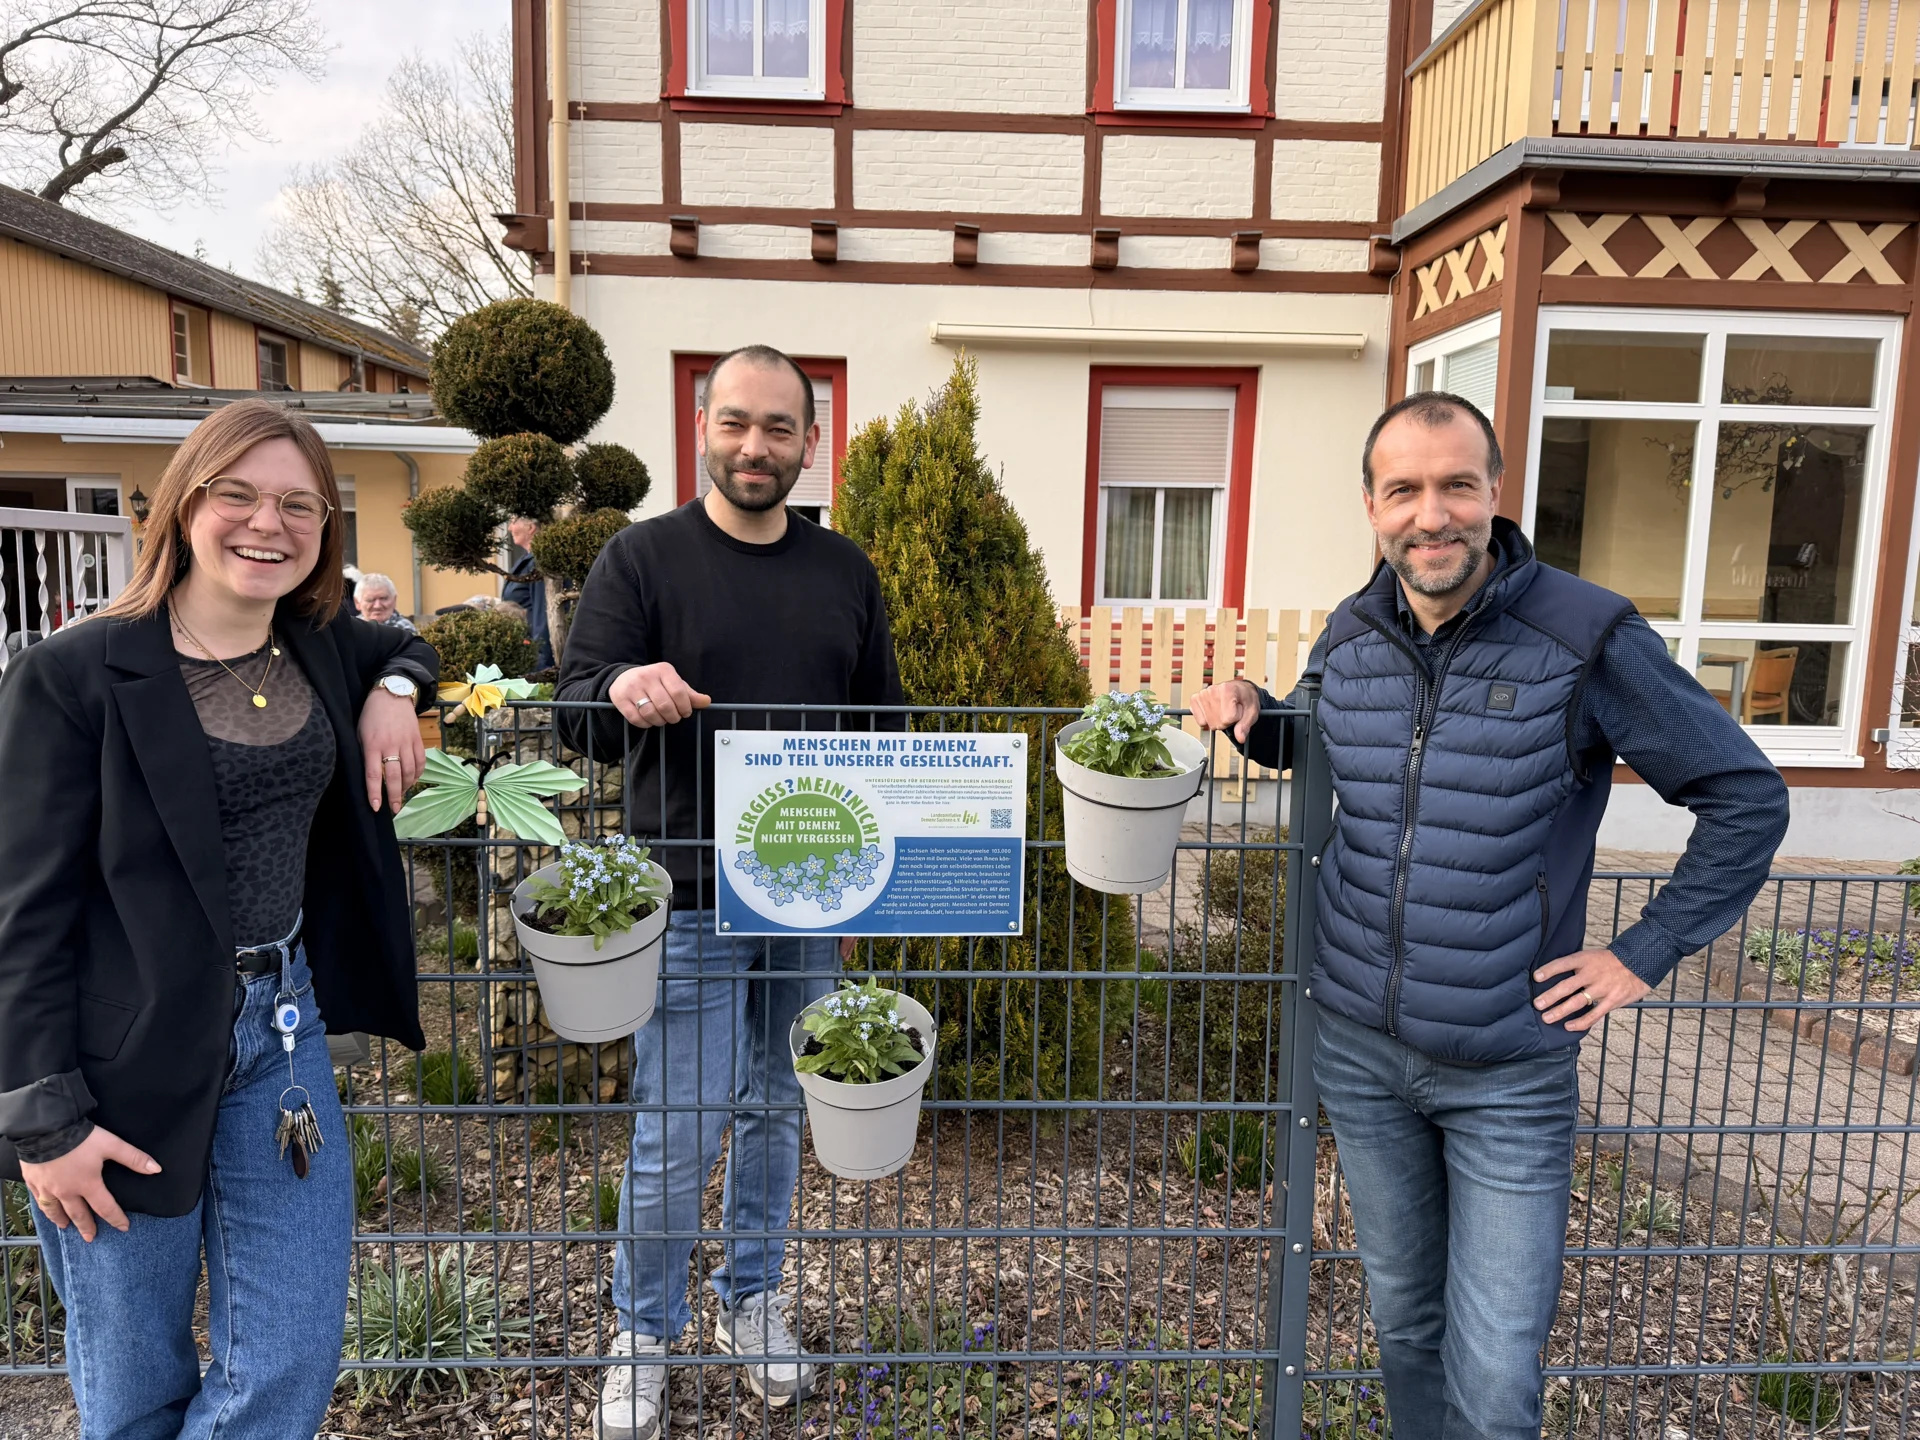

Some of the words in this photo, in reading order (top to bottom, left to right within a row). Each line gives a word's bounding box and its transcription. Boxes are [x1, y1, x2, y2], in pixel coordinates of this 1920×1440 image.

[783, 739, 870, 751] MENSCHEN
[877, 739, 906, 751] MIT
[913, 740, 976, 751] DEMENZ
[745, 753, 782, 766] SIND
[788, 754, 818, 766] TEIL
[824, 754, 894, 767] UNSERER
[900, 754, 1013, 767] GESELLSCHAFT.
[780, 808, 836, 817] MENSCHEN
[776, 821, 795, 830] MIT
[799, 821, 840, 830] DEMENZ
[762, 834, 792, 843] NICHT
[796, 834, 854, 844] VERGESSEN
